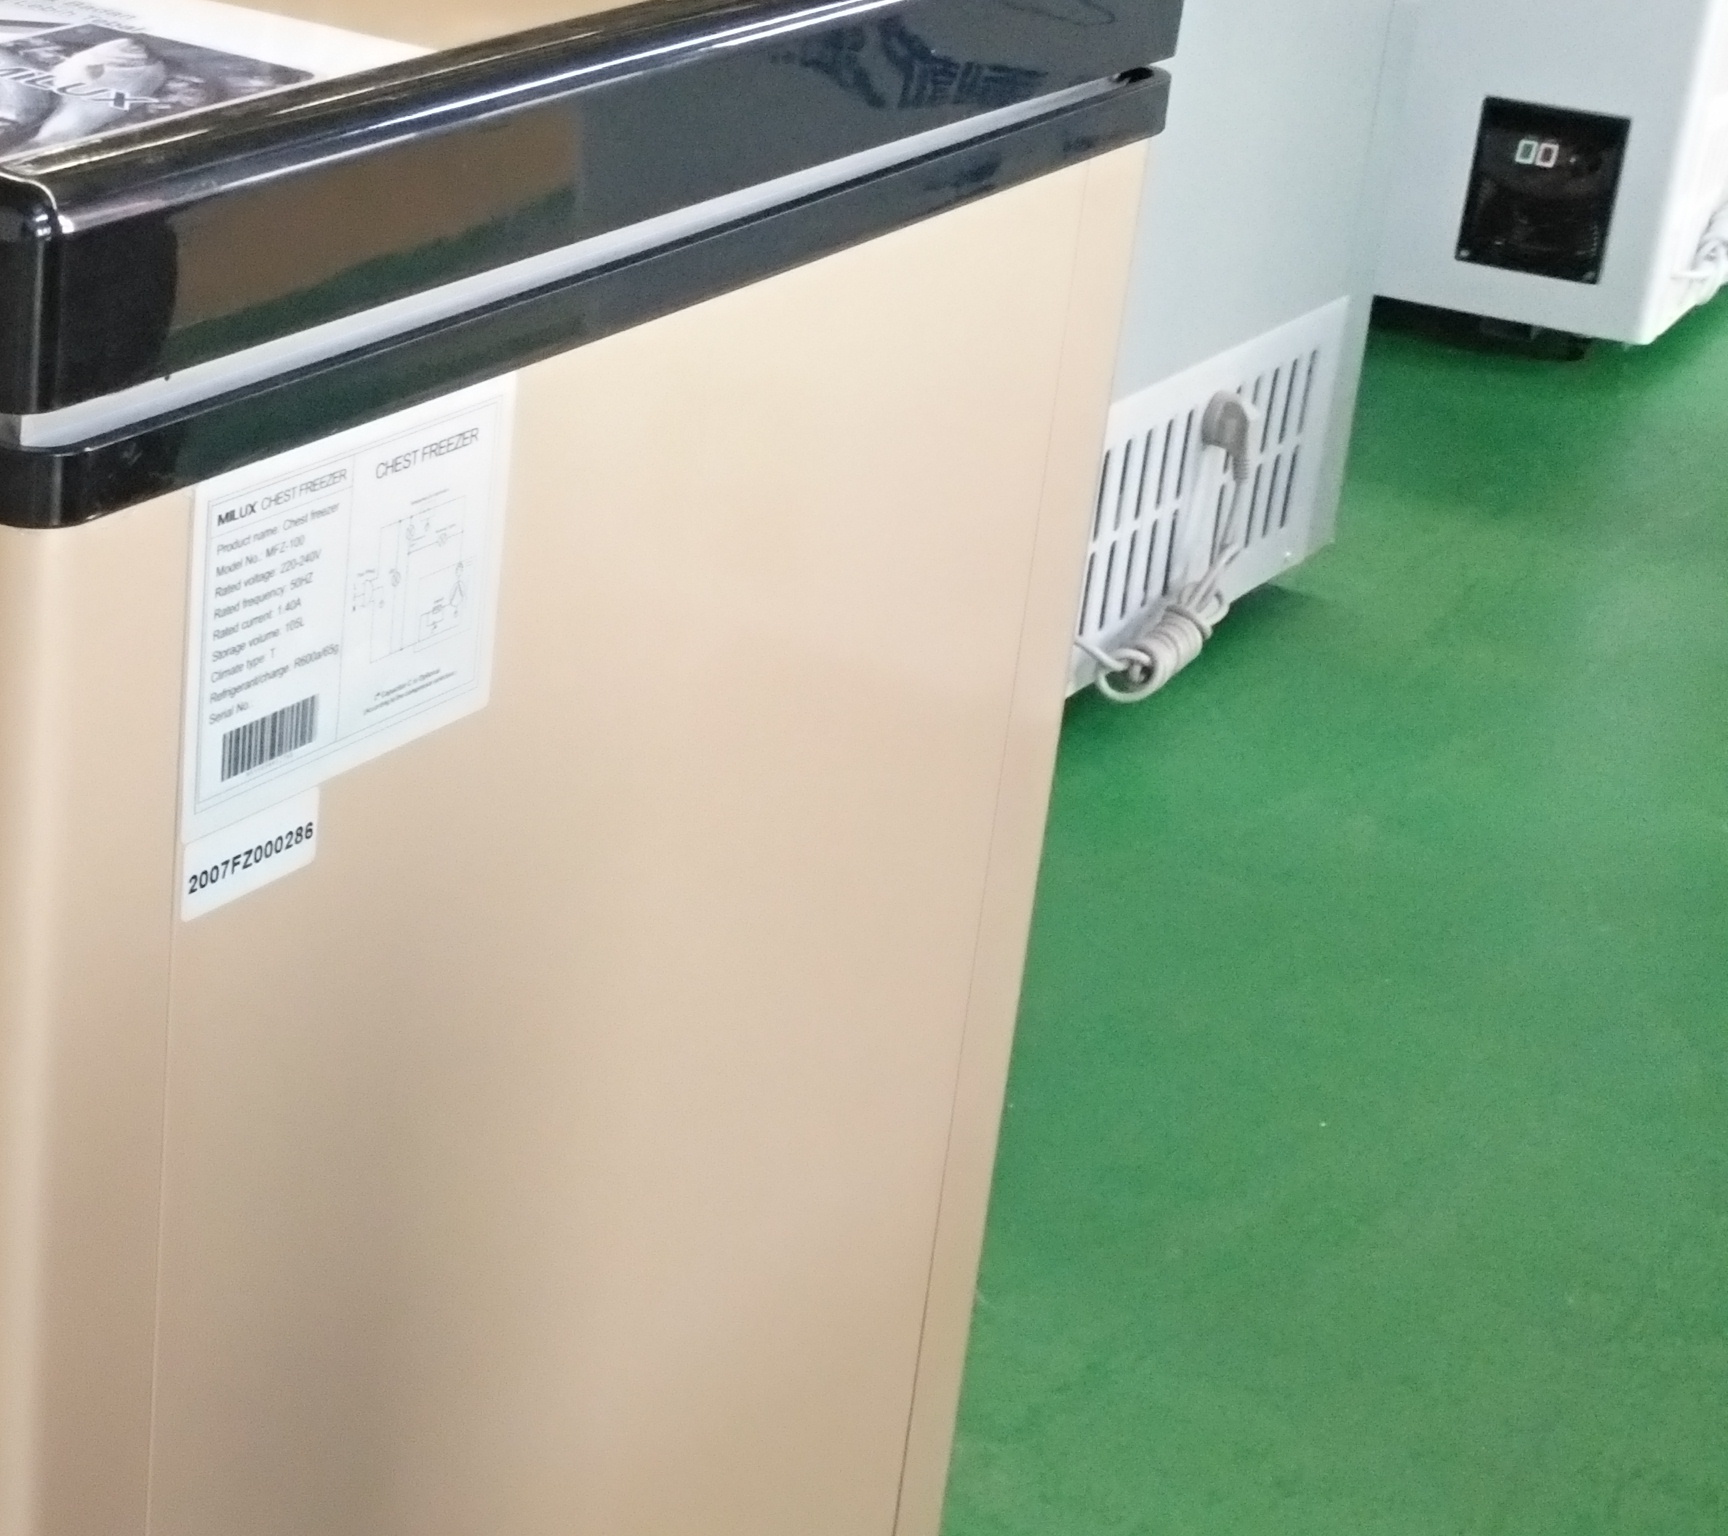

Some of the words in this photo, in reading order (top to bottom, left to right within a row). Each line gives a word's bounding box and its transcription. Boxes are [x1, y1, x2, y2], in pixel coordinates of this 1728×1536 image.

[374, 449, 419, 480] CHEST
[420, 426, 480, 462] FREEZER
[217, 501, 257, 526] MILUX
[261, 486, 297, 510] CHEST
[299, 468, 347, 496] FREEZER
[216, 534, 251, 555] Product
[282, 512, 308, 531] Chest
[309, 501, 339, 520] freezer
[214, 579, 241, 598] Rated
[279, 548, 322, 573] 220-240V
[215, 558, 242, 576] Model
[265, 534, 305, 557] MFZ-100
[212, 622, 239, 641] Rated
[213, 601, 240, 620] Rated
[210, 660, 244, 683] Climate
[211, 639, 246, 664] Storage
[208, 705, 233, 725] Serial
[187, 821, 314, 895] 2007FZ000286
